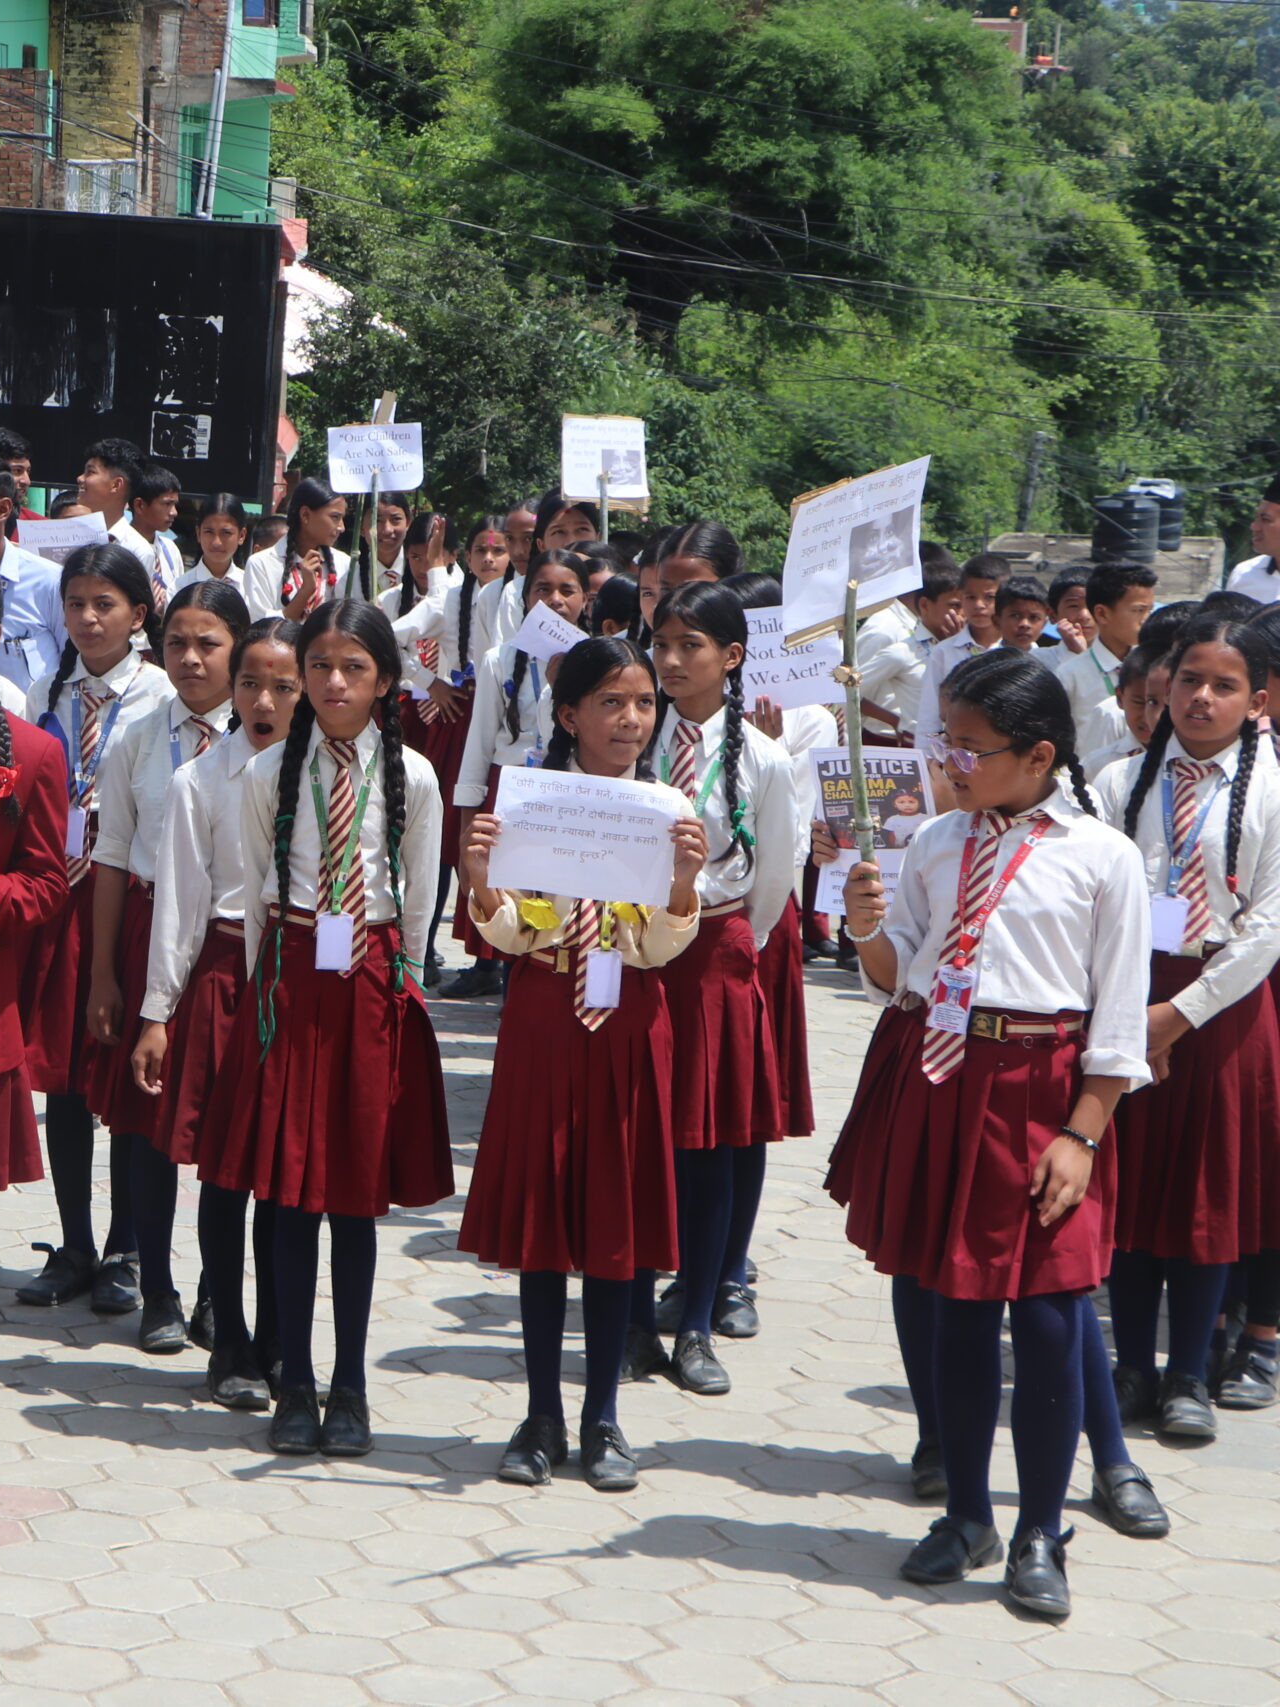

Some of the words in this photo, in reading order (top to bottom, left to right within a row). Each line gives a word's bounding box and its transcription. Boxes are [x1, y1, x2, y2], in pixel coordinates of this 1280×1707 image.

[367, 431, 411, 441] Children
[344, 449, 362, 459] Are
[366, 448, 384, 457] Not
[387, 447, 408, 456] Safe
[340, 465, 364, 475] Until
[746, 617, 784, 635] Chil
[746, 646, 776, 661] Not
[748, 670, 780, 686] We
[823, 778, 897, 792] GAMA
[824, 789, 890, 800] CHAUARY
[983, 877, 1008, 912] ACADEMY
